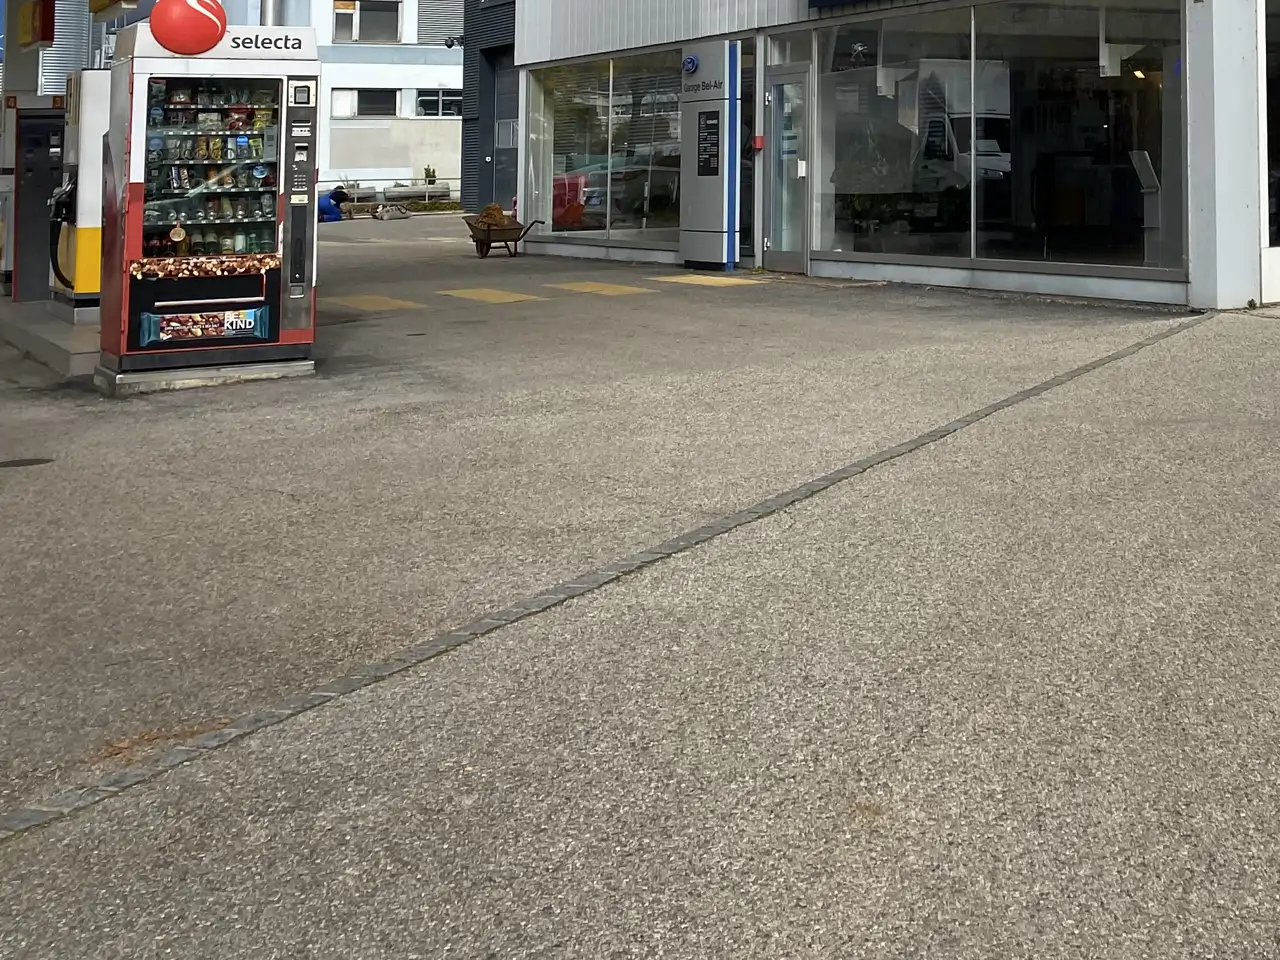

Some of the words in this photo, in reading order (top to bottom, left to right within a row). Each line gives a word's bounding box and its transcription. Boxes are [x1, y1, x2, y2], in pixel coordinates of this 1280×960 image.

[230, 34, 302, 50] selecta
[683, 83, 701, 93] Garage
[701, 79, 724, 91] Bel-Air
[224, 319, 255, 330] KIND
